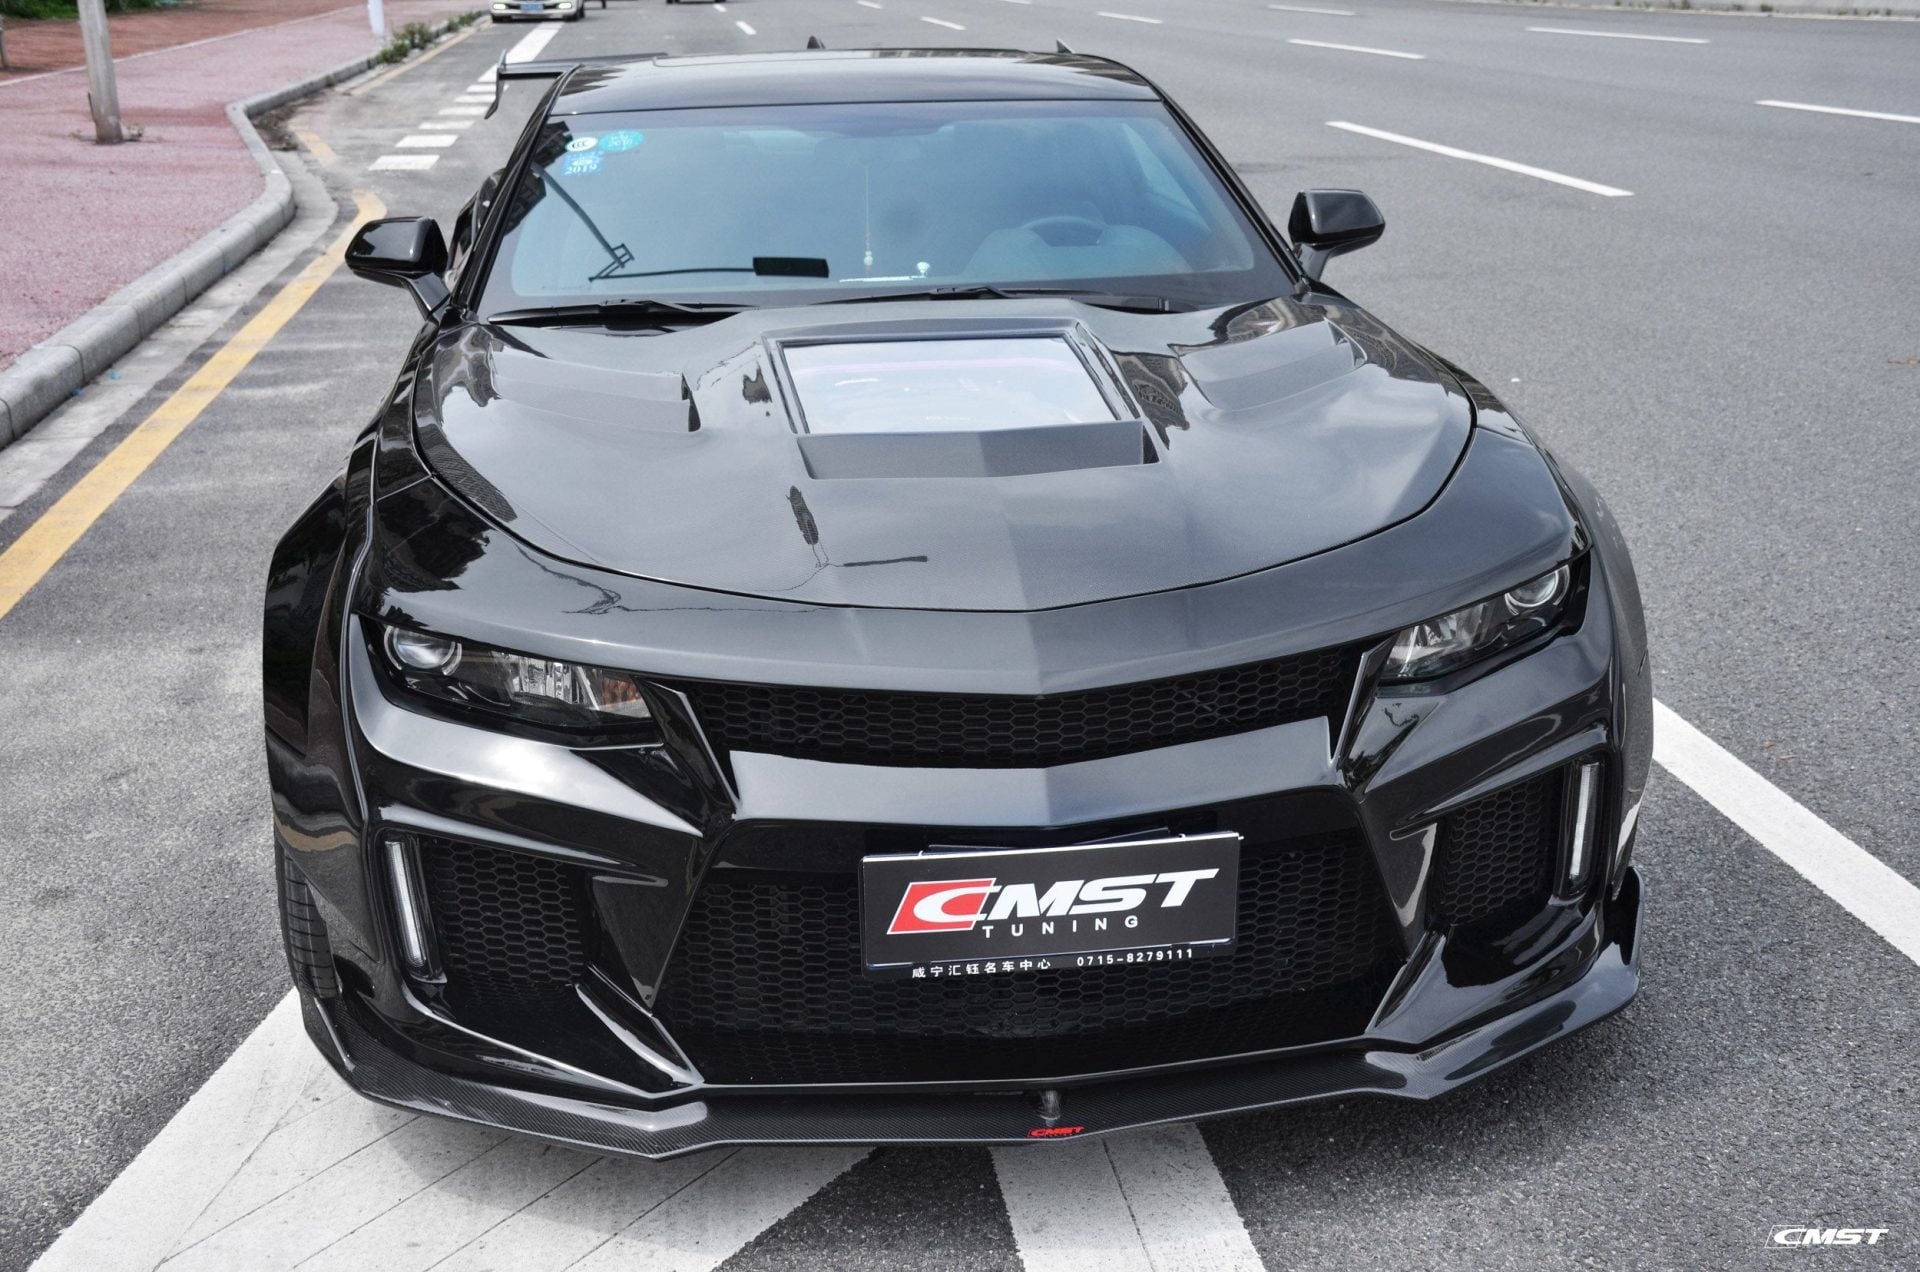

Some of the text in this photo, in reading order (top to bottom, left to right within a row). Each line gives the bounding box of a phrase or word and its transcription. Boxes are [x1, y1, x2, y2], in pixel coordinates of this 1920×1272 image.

[912, 868, 1220, 922] CMST
[982, 915, 1138, 939] TUNING
[1076, 948, 1192, 966] 0715-8279111
